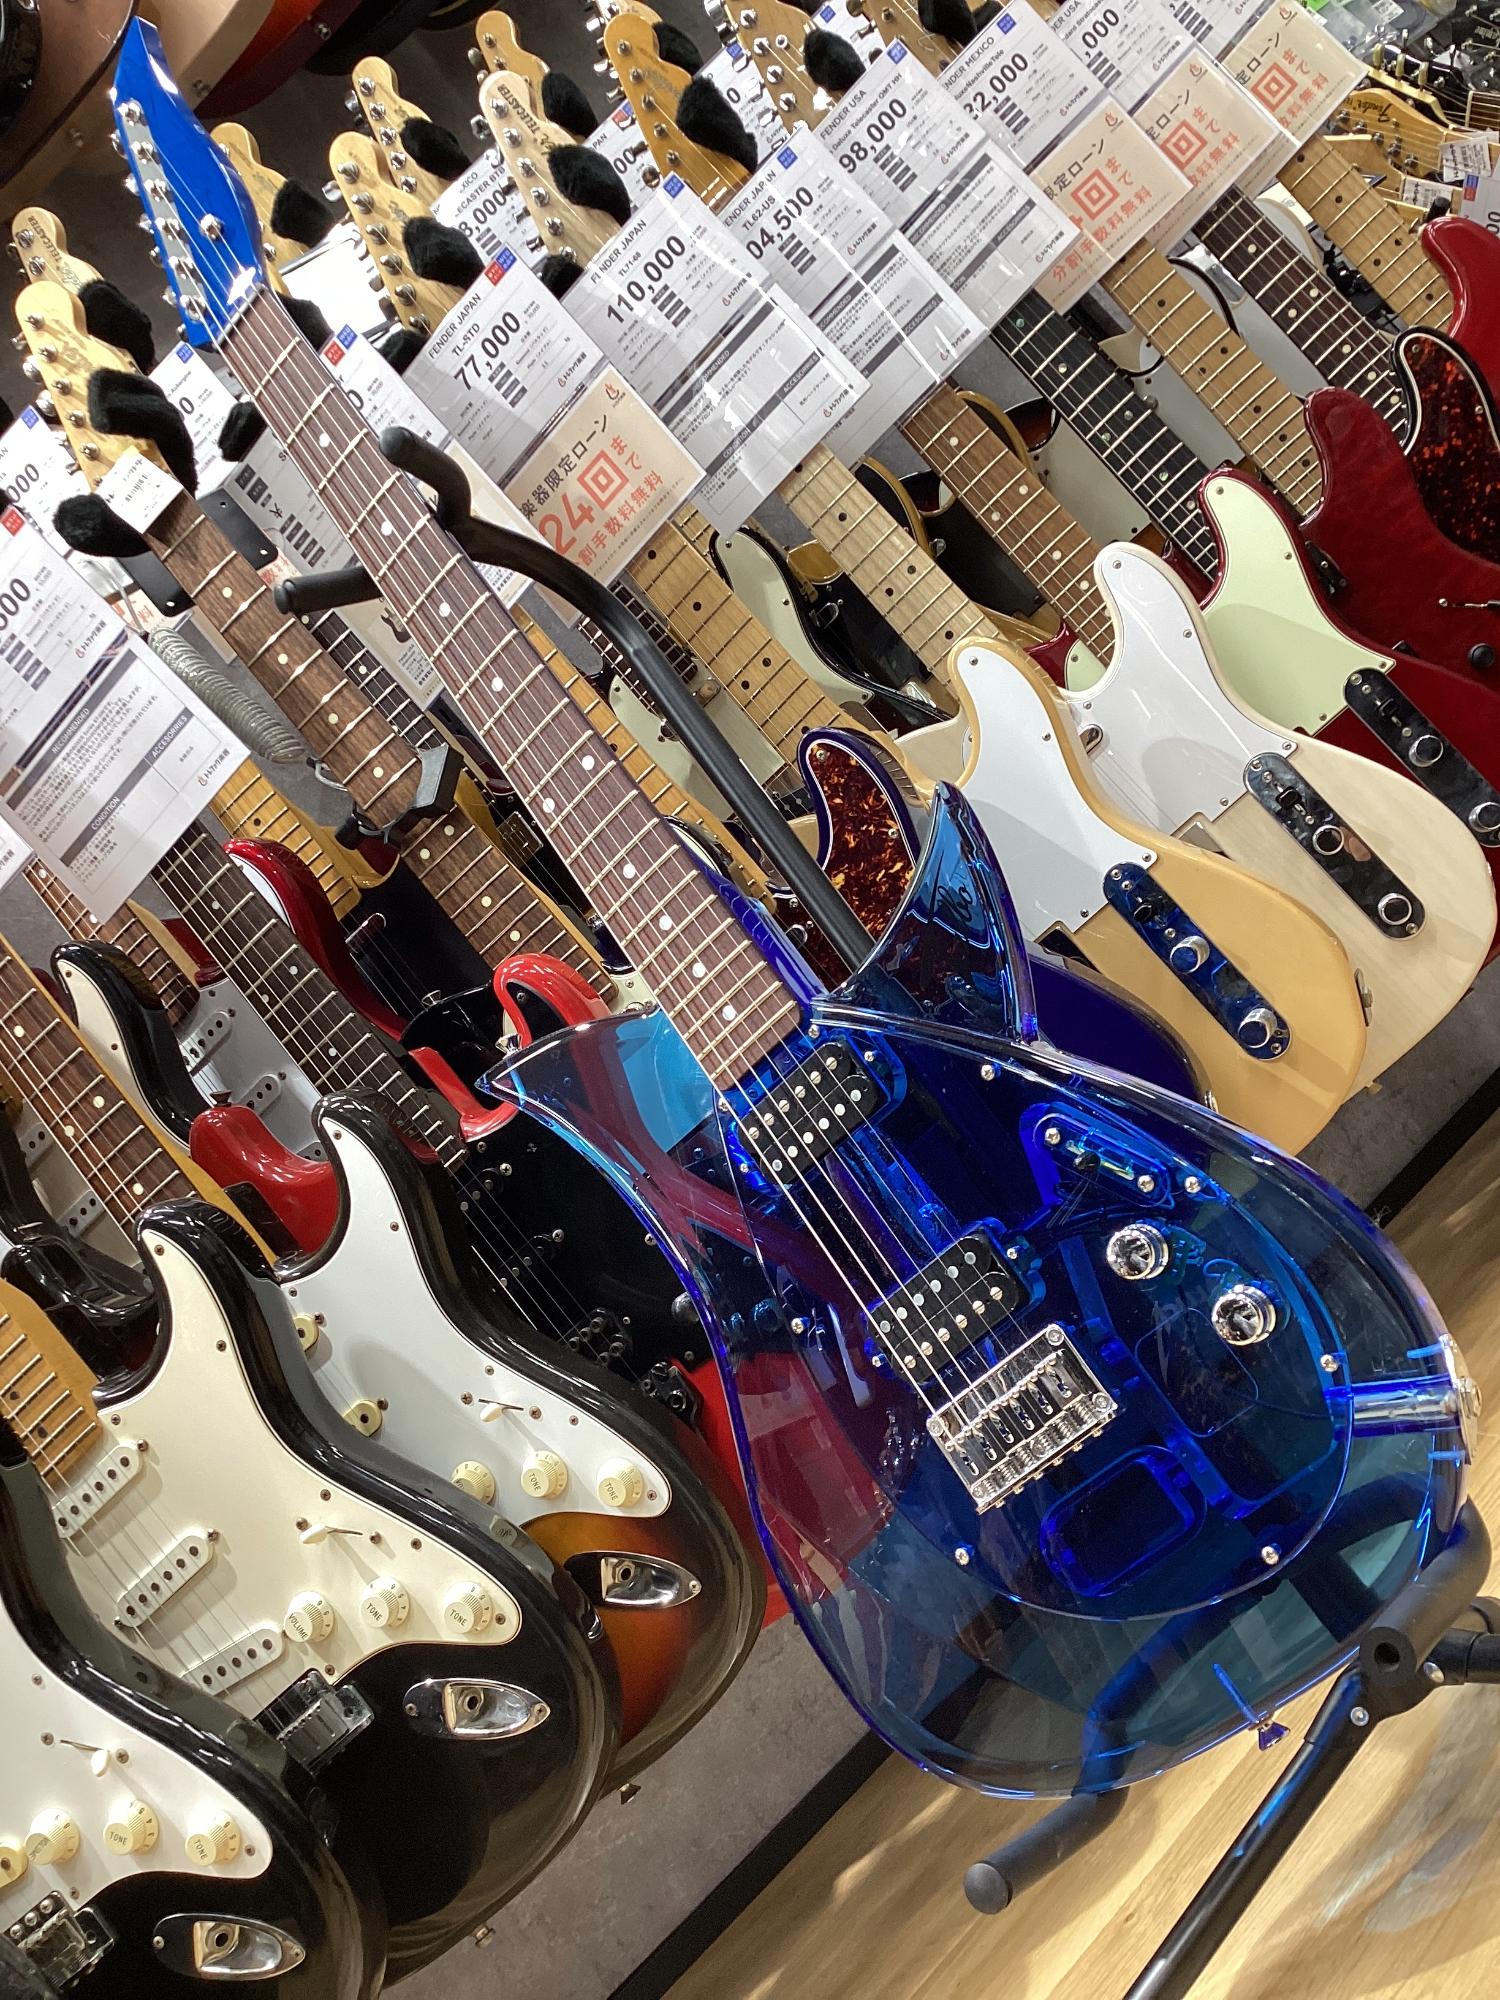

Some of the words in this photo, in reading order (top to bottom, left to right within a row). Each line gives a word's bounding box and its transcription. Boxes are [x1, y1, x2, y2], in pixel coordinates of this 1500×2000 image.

[1063, 0, 1081, 18] USA
[1074, 6, 1122, 59] ,000
[964, 35, 995, 67] MEXICO
[496, 83, 542, 135] TELECASTER
[819, 105, 852, 140] FENDER
[848, 88, 867, 108] USA
[836, 96, 910, 176] 98,000
[722, 195, 751, 228] ENDER
[741, 194, 777, 231] TL62-US
[743, 184, 816, 262] 04,500
[27, 215, 62, 262] TELECASTER
[617, 218, 647, 250] JAPAN
[601, 232, 689, 327] 110,000
[425, 321, 459, 359] FENDER
[454, 292, 482, 325] JAPAN
[450, 321, 482, 357] TL-STD
[452, 309, 524, 392] 77,000
[517, 412, 613, 520] 楽器限定ローン
[575, 467, 666, 567] 割手数料無料
[50, 706, 91, 754] RECOMMENDED
[90, 795, 120, 831] CONDITION
[529, 1473, 542, 1492] TONE
[605, 1482, 617, 1501] TONE
[288, 1613, 309, 1640] VOLUME
[366, 1602, 383, 1622] TONE
[449, 1609, 467, 1627] TONE
[109, 1831, 128, 1845] TONE
[192, 1839, 209, 1860] TONE
